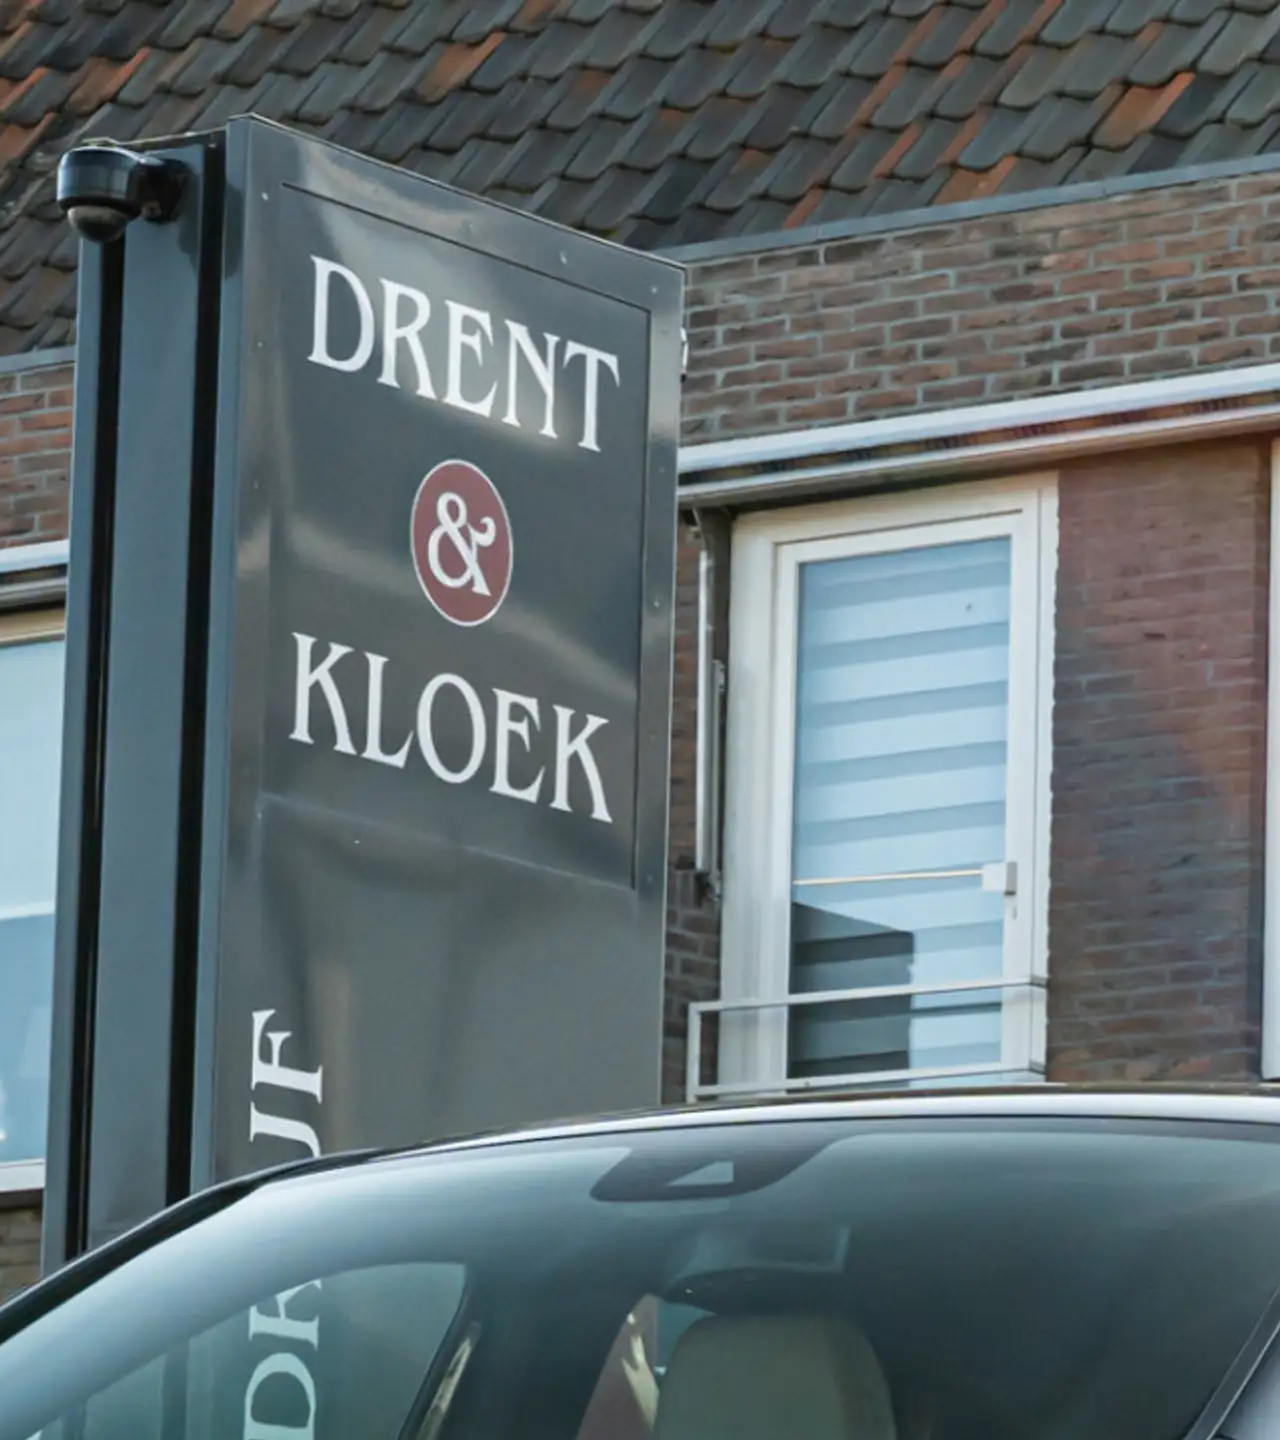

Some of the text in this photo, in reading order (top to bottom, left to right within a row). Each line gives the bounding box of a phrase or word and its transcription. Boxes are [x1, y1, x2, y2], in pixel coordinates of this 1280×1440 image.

[307, 255, 620, 452] DRENT
[427, 491, 497, 598] &
[289, 632, 613, 824] KLOEK
